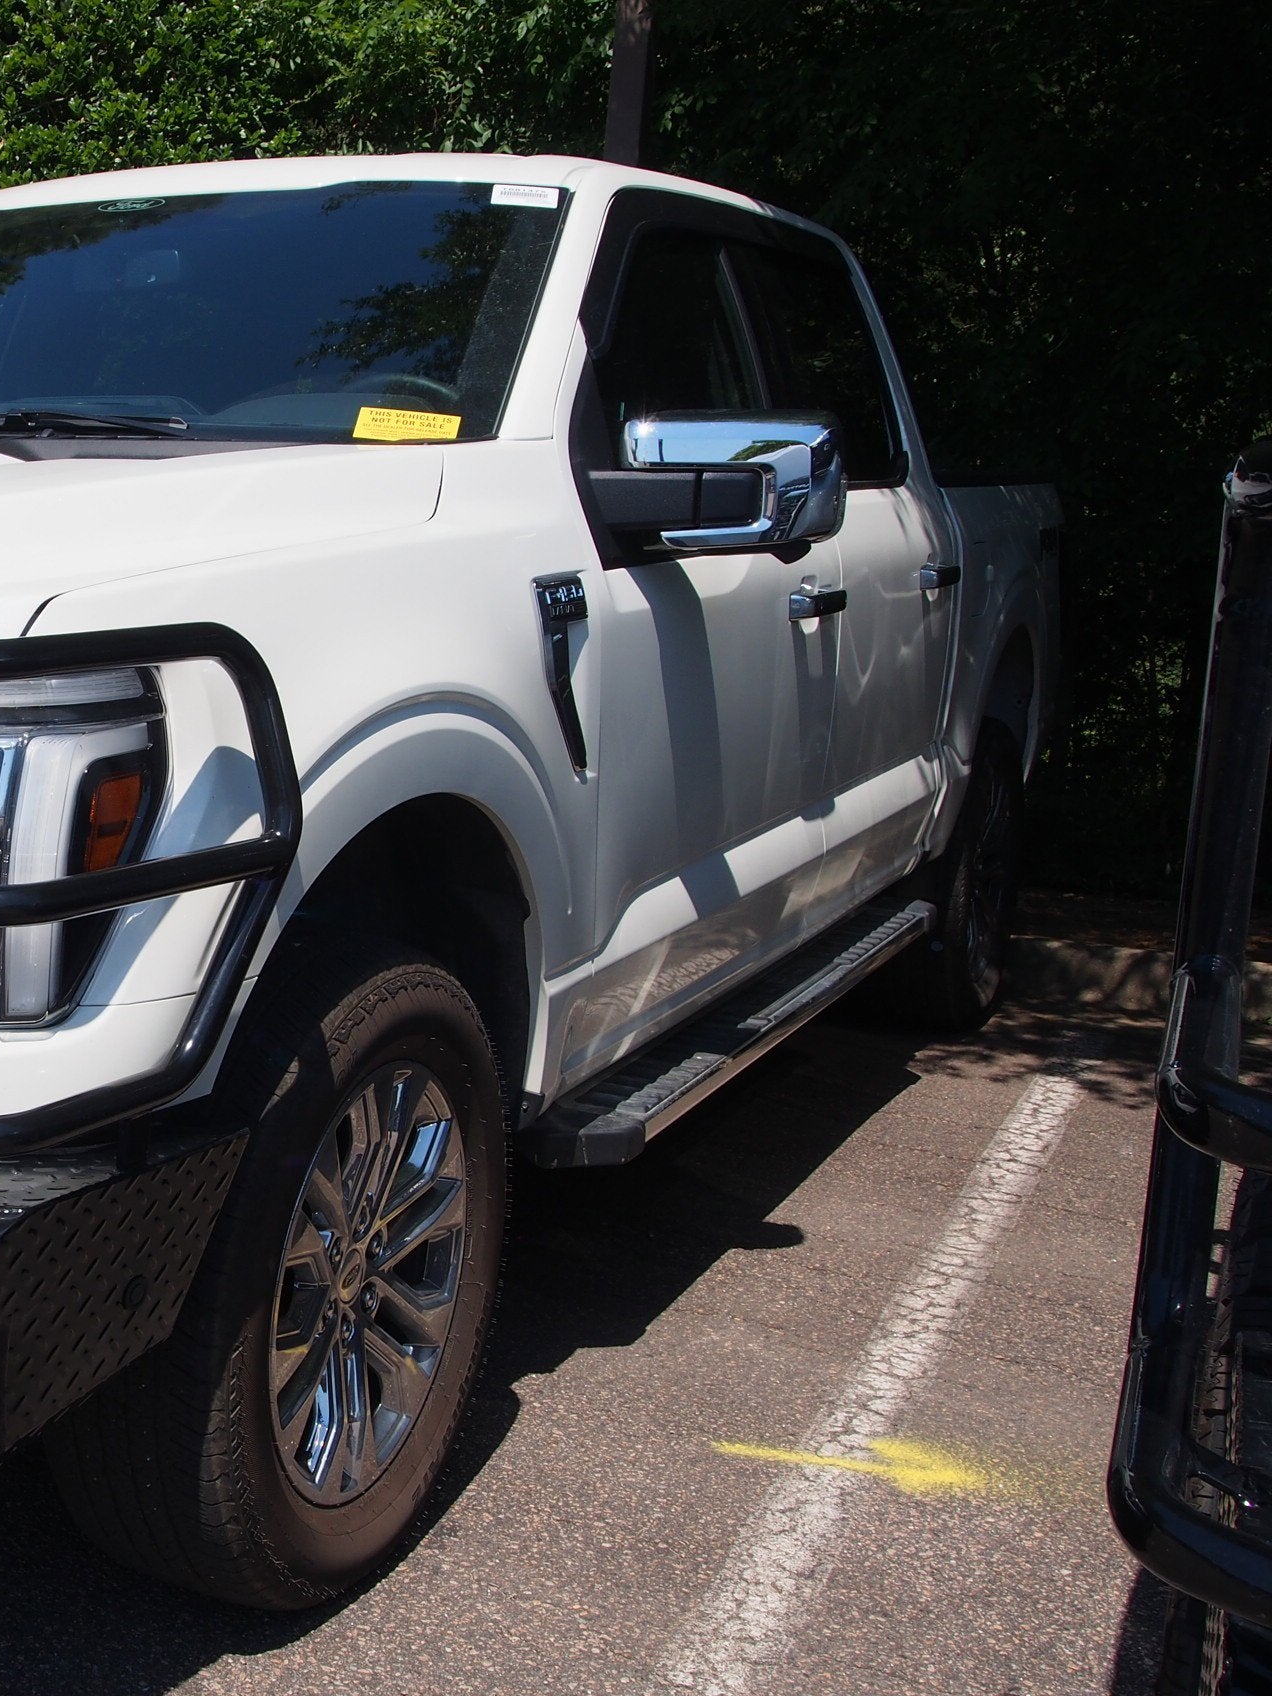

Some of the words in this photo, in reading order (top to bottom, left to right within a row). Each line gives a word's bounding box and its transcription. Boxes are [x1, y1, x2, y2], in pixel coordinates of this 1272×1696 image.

[369, 410, 392, 418] THIS
[395, 413, 439, 422] VEHICLE
[419, 421, 445, 430] SALE
